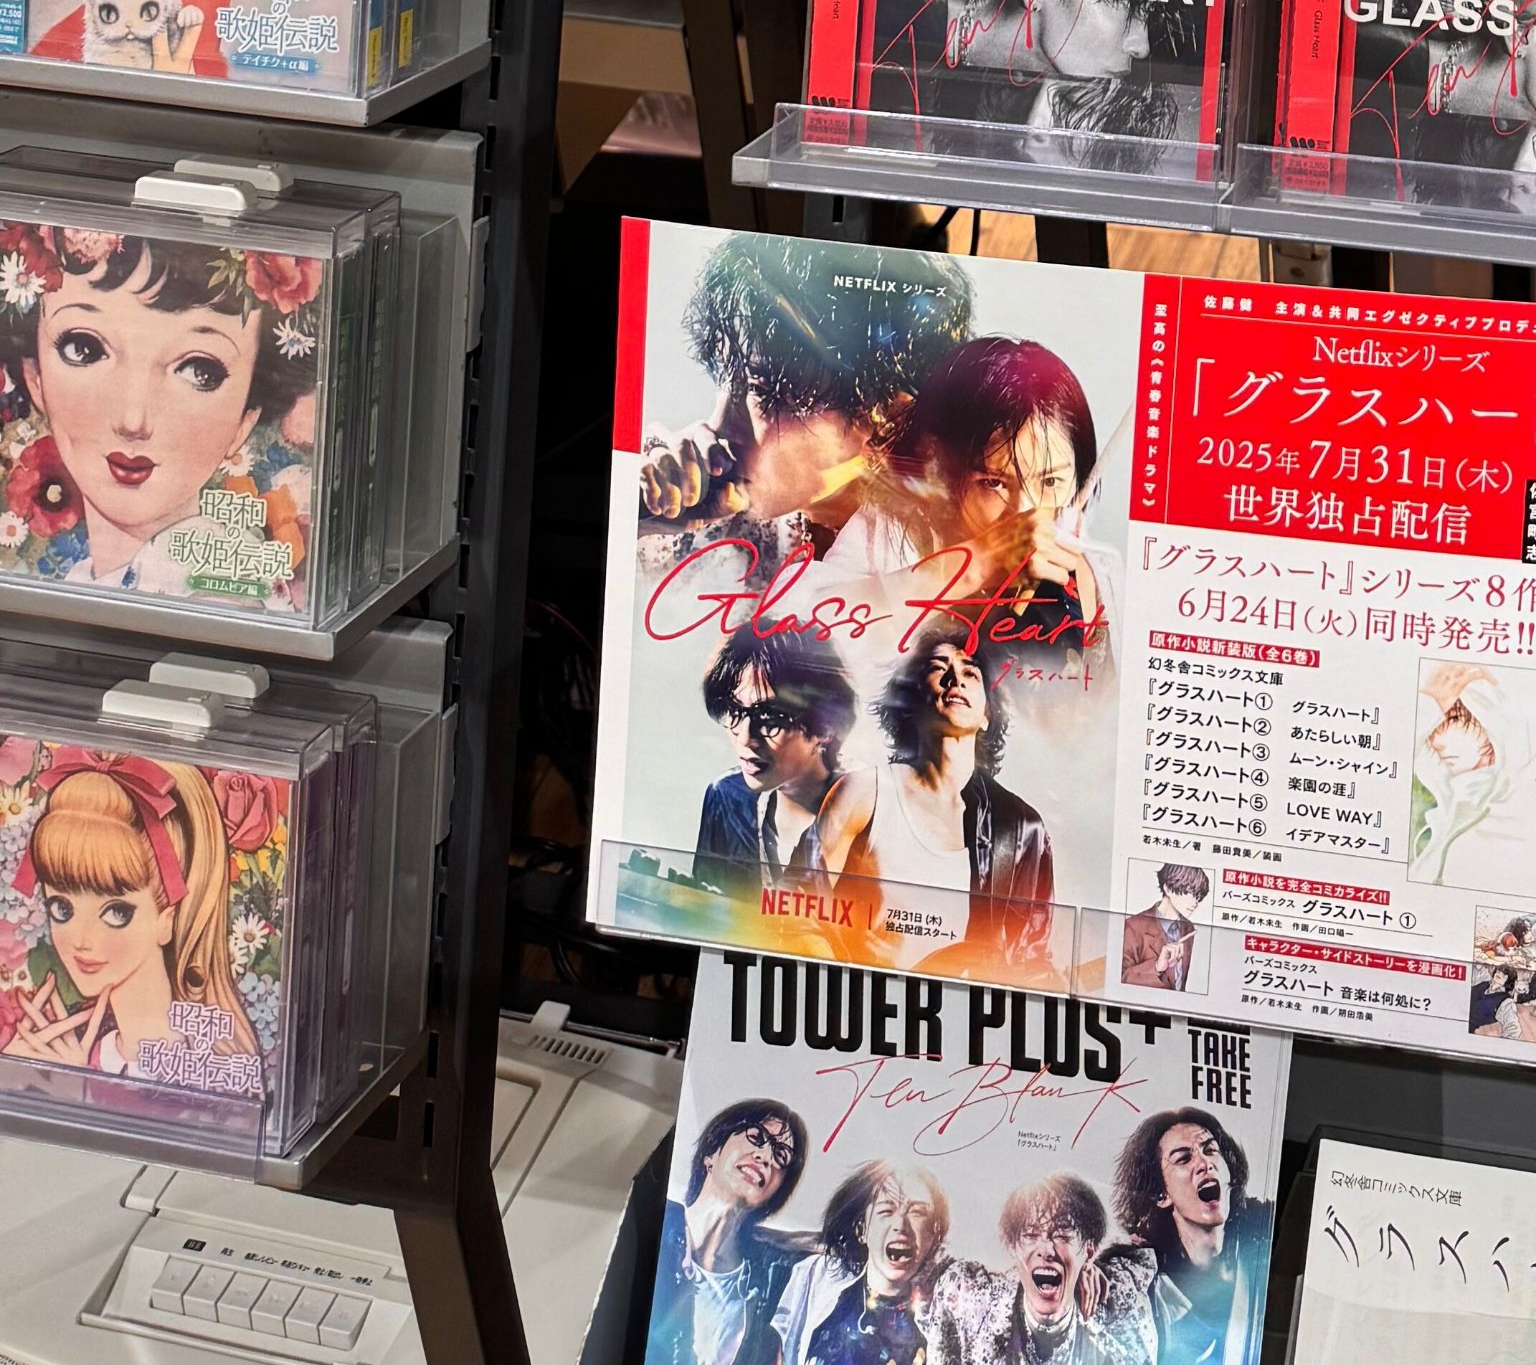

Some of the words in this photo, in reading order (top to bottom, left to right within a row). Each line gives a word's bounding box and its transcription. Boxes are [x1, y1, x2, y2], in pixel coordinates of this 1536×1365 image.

[216, 7, 340, 53] 歌姫伝説
[834, 275, 898, 295] NETFLIX
[901, 281, 948, 299] シリーズ
[1204, 294, 1254, 313] 佐藤健
[1312, 337, 1491, 373] Netflixシリーズ
[1196, 436, 1514, 496] 2025年7月31日(木)
[201, 489, 267, 527] 昭和
[1224, 483, 1471, 547] 世界独占配信
[170, 529, 294, 579] 歌姫伝説
[644, 538, 892, 641] Glass
[897, 547, 1111, 654] Heart
[1178, 589, 1535, 656] 6月24日(火)同時発売!!
[1147, 656, 1284, 687] 幻冬舎コミックス文庫
[1150, 632, 1319, 668] 原作小説新装版(全6巻)
[1148, 677, 1273, 710] 『グラスハート①
[1292, 699, 1380, 725] グラスハート』
[1146, 702, 1272, 736] 『グラスハート②
[1290, 724, 1382, 751] あたらしい朝』
[1144, 752, 1269, 787] 『グラスハート④
[1287, 777, 1356, 800] 楽園の涯』
[1145, 728, 1271, 762] 『グラスハート③
[1289, 751, 1398, 779] ムーン・シャイン』
[1143, 778, 1268, 812] 『グラスハート⑤
[1286, 804, 1331, 822] LOVE
[1335, 809, 1383, 829] WAY』
[1143, 803, 1267, 837] 『グラスハート⑥
[1285, 827, 1390, 854] イデアマスター』
[760, 888, 856, 929] NETFLIX
[1223, 870, 1389, 906] 原作小説を完全コミカライズ!!
[723, 955, 944, 1063] TOWER
[1243, 969, 1335, 997] グラスハート
[1340, 984, 1432, 1011] 音楽は何処に？
[169, 1001, 234, 1042] 昭和
[139, 1040, 264, 1093] 歌姫伝説
[1188, 1028, 1252, 1073] TAKE
[1190, 1073, 1252, 1109] FREE
